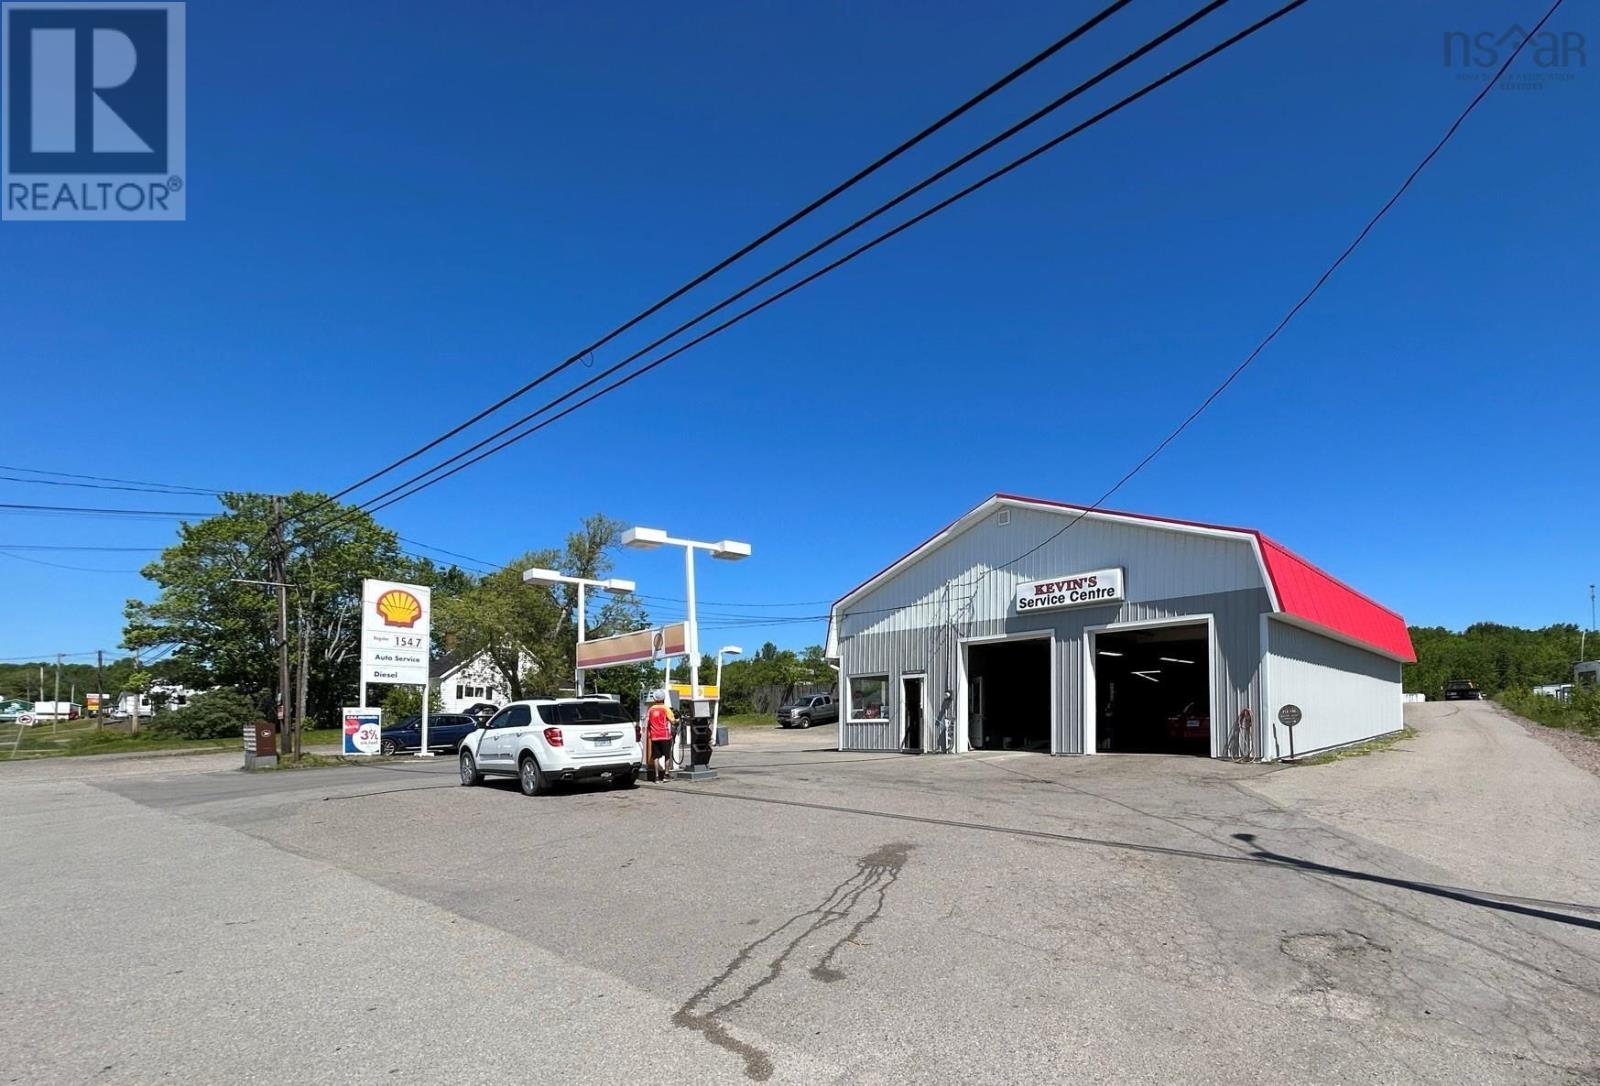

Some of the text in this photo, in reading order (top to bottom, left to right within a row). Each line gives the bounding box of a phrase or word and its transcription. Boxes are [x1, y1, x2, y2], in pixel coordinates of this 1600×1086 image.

[1034, 576, 1098, 595] KEVIN'S
[1019, 587, 1115, 609] Service Centre
